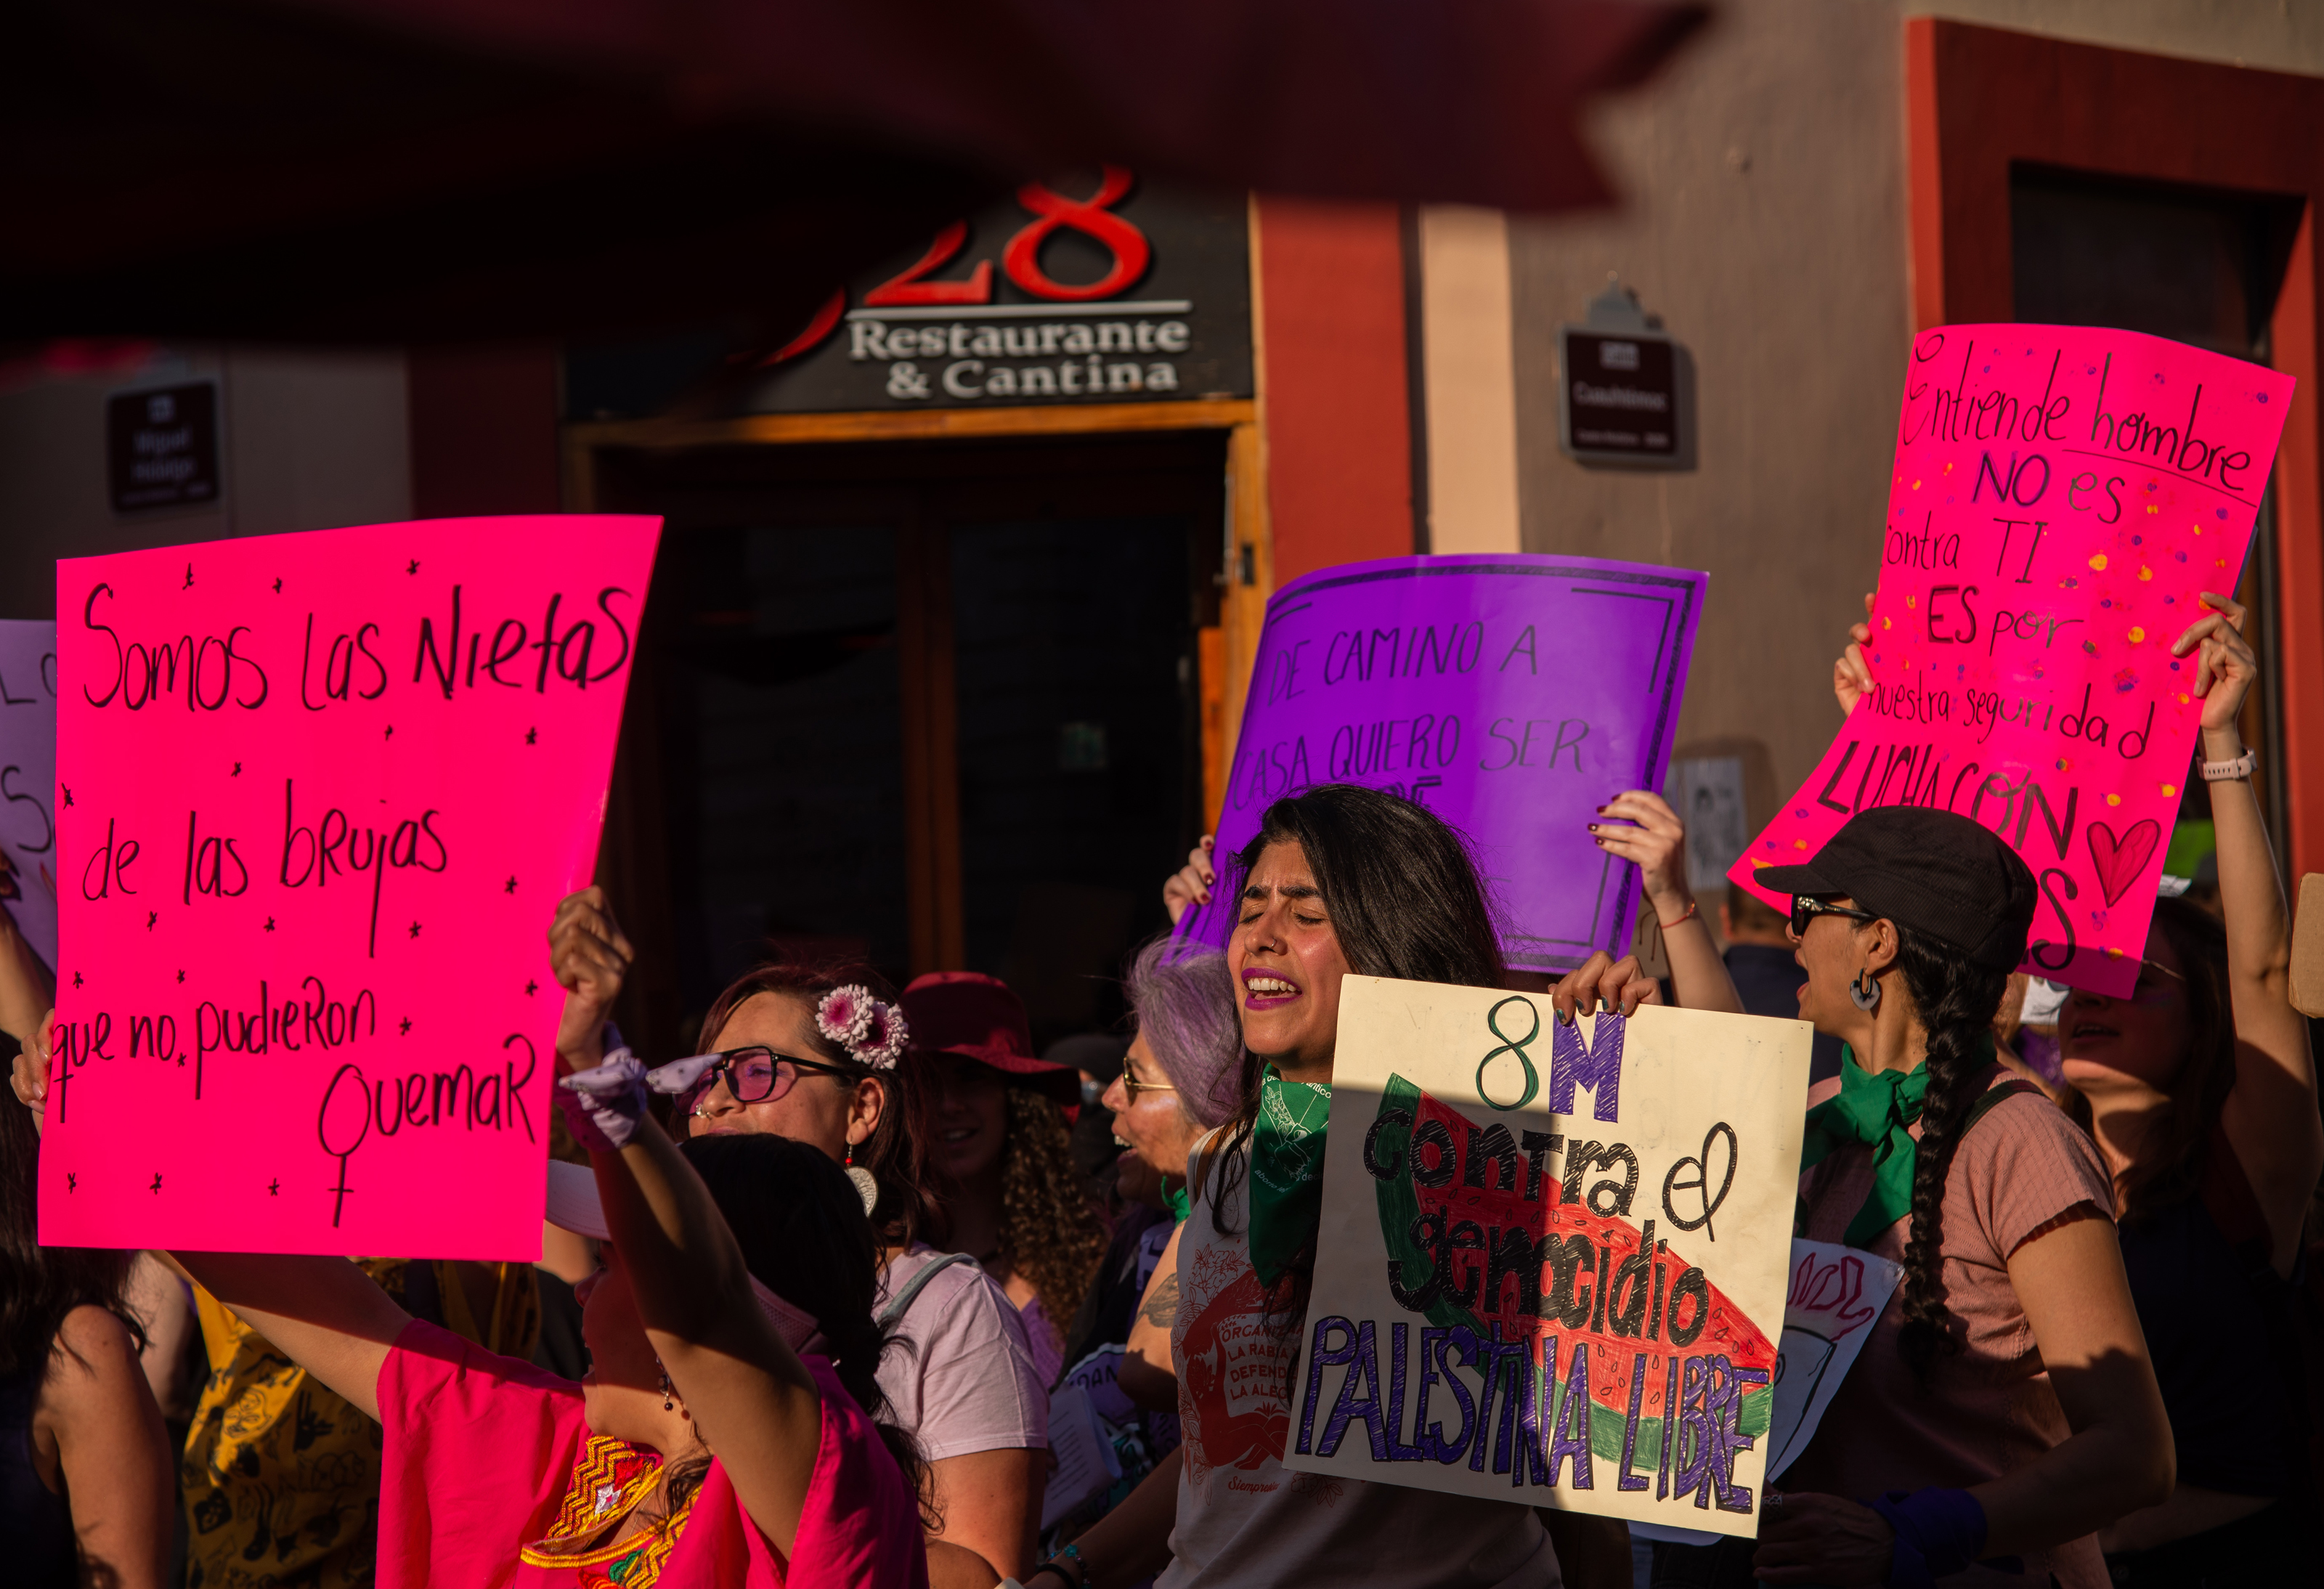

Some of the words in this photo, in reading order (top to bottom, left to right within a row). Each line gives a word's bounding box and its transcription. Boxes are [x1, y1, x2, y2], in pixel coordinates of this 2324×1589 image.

[848, 318, 1192, 361] Restaurante
[886, 362, 932, 399] &
[943, 354, 1179, 399] Cantina
[1901, 333, 2071, 446] Entiende
[2089, 351, 2252, 492] hombre
[1970, 449, 2052, 508] NO
[2067, 471, 2126, 524] es
[1881, 510, 1960, 570] ontra
[1993, 517, 2049, 584] TI
[84, 582, 269, 712] Somos
[1267, 639, 1312, 708] DE
[1323, 620, 1484, 687] CAMINO
[1498, 624, 1538, 676] A
[1927, 584, 1980, 644] ES
[1988, 610, 2084, 657] por
[1866, 670, 1950, 725] nuestra
[1962, 682, 2156, 760] seguridad
[1233, 735, 1313, 813] CASA
[1328, 713, 1461, 783] QUIERO
[1478, 716, 1590, 774] SER
[82, 818, 140, 901] de
[183, 810, 249, 906] las
[49, 1009, 115, 1124] que
[129, 1012, 177, 1061] no
[1476, 995, 1627, 1124] 8M
[1661, 1121, 1739, 1243] el
[1386, 1204, 1711, 1348] genocidio
[1227, 1345, 1246, 1362] LA
[1249, 1343, 1289, 1360] RABIA
[1230, 1384, 1248, 1401] LA
[1294, 1314, 1595, 1492] PALESTINA
[1617, 1352, 1770, 1516] LIBRE
